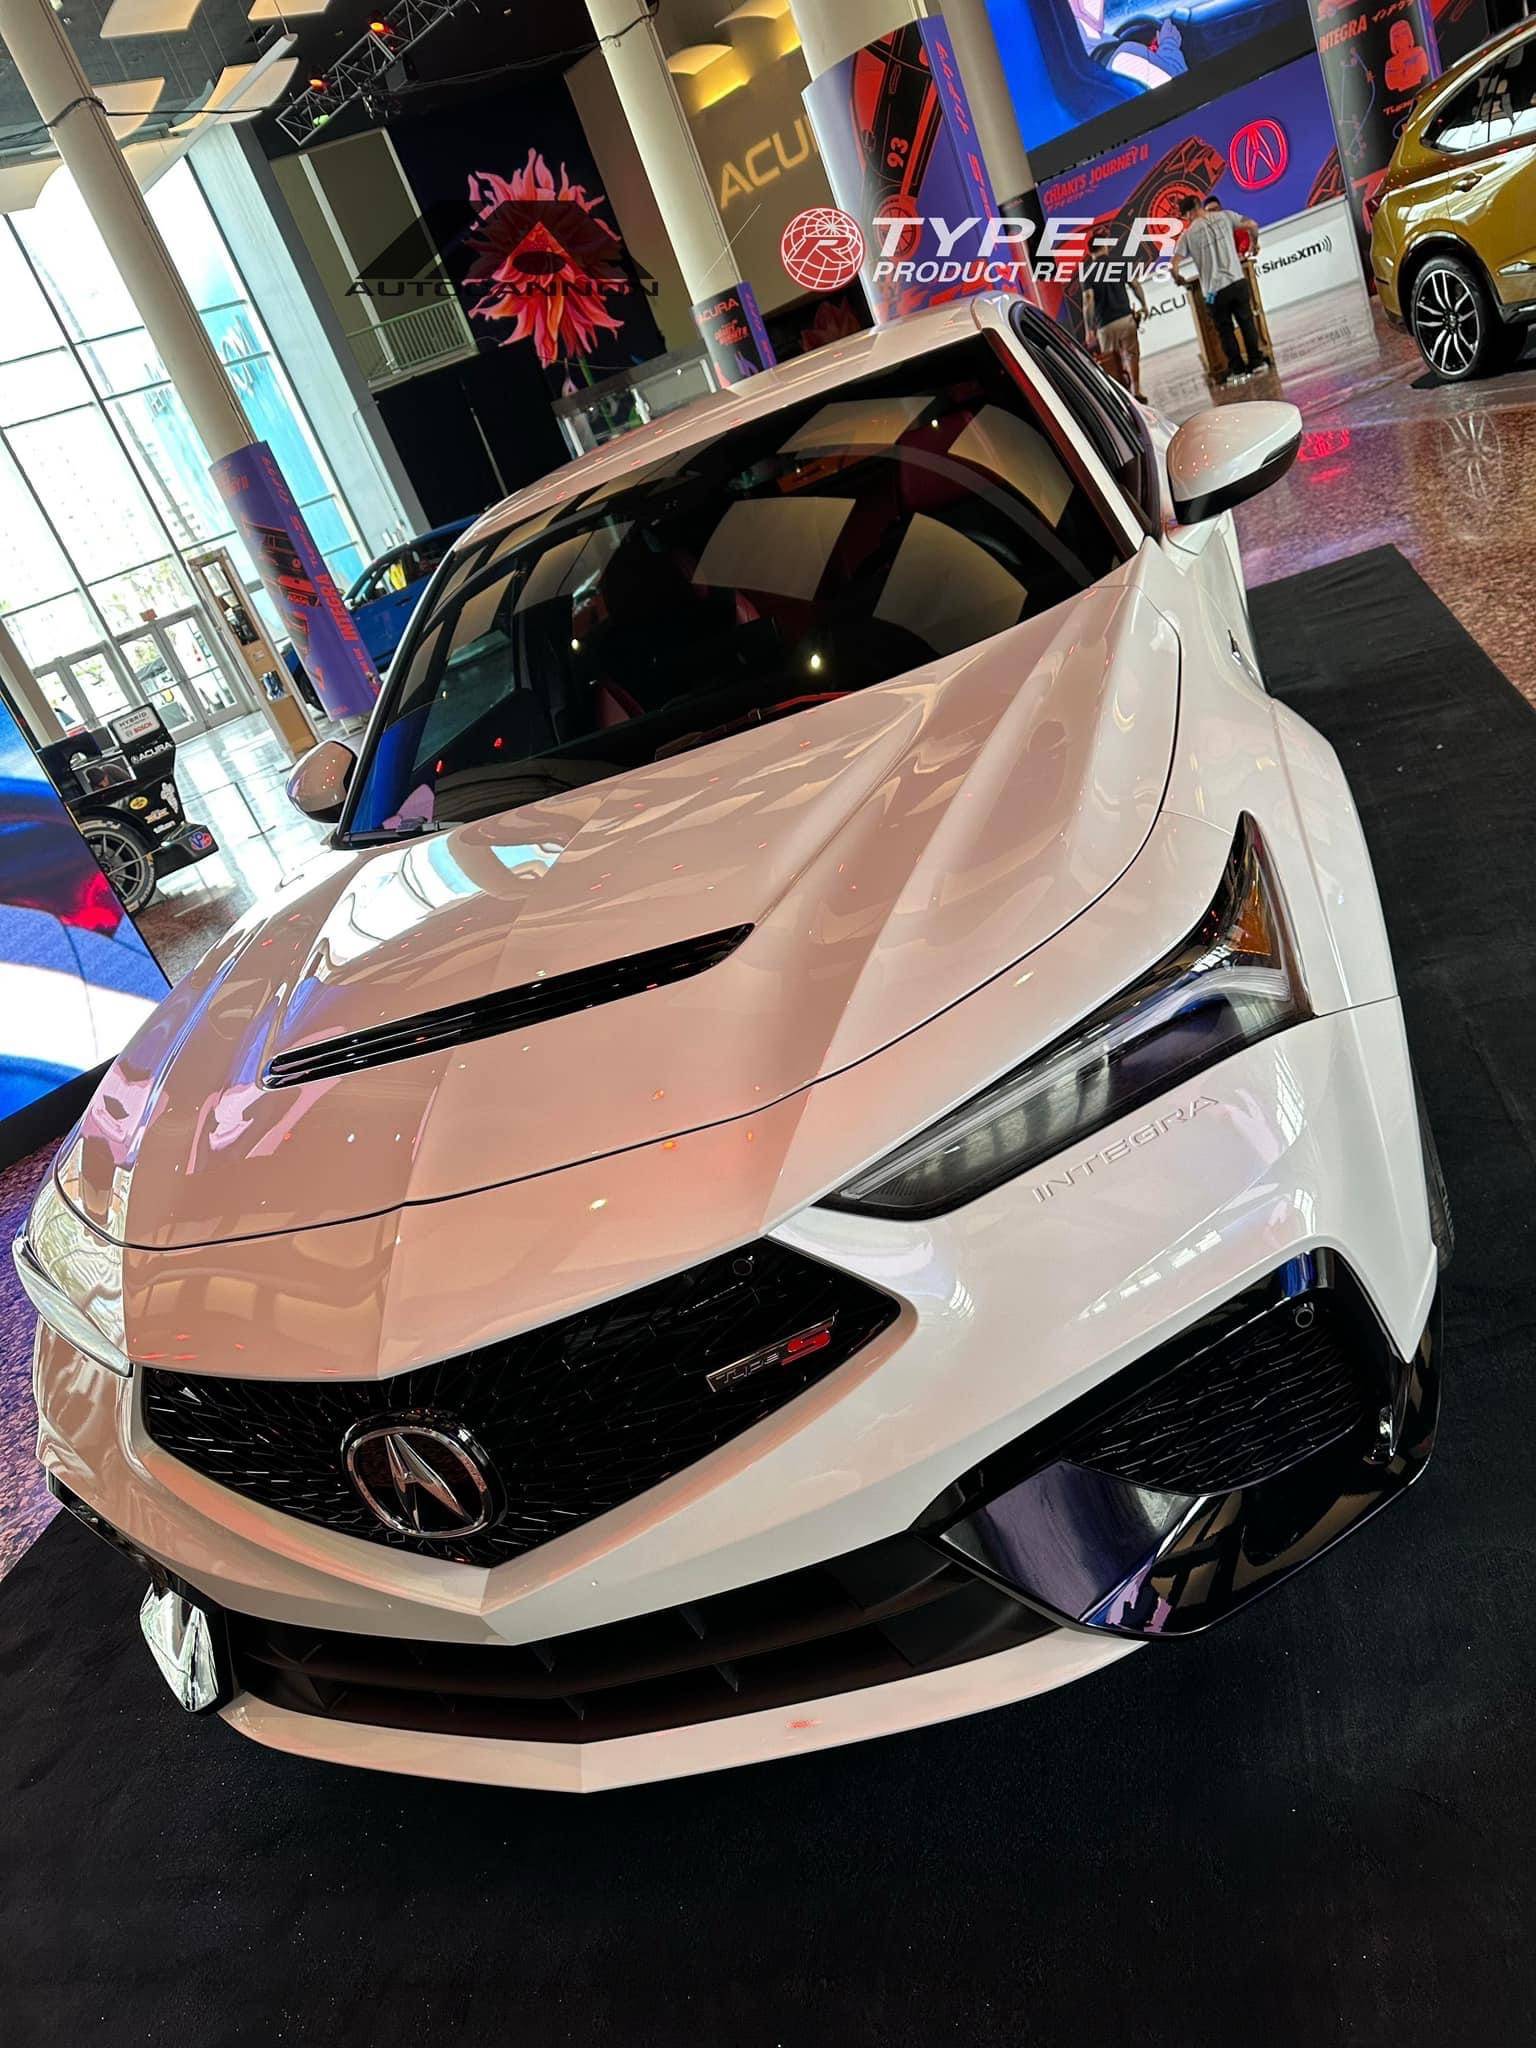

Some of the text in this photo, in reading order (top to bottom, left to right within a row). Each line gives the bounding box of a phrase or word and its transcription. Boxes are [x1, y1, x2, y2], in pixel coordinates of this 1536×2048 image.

[720, 114, 818, 210] ACU
[886, 136, 909, 168] 93
[1087, 145, 1138, 188] JOURNEY
[138, 741, 173, 763] ACURA
[1031, 1095, 1220, 1204] INTEGRA
